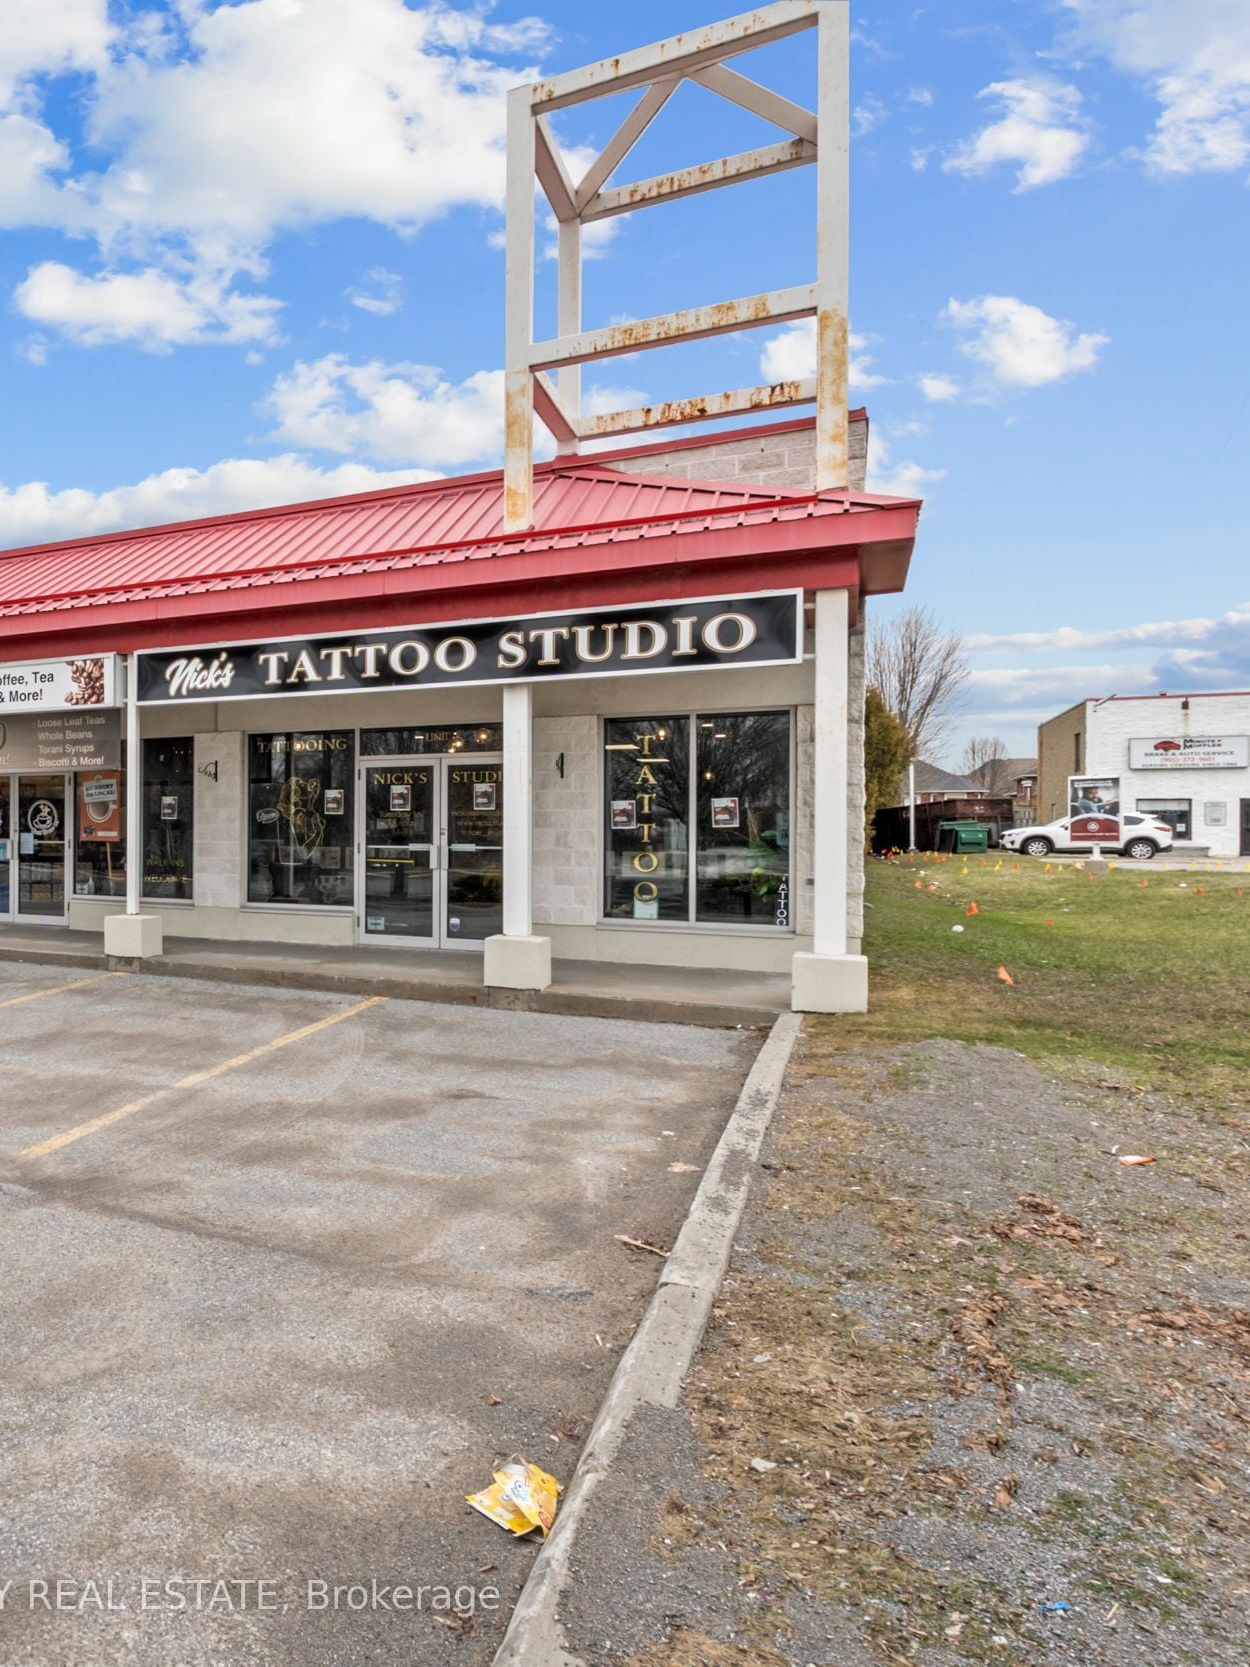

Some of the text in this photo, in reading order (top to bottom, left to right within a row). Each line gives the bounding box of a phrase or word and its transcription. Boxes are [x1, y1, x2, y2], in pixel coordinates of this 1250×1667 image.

[164, 611, 758, 697] Nick's TATTOO STUDIO
[31, 671, 55, 684] Tea
[8, 689, 43, 703] More!
[37, 715, 106, 728] Loose Leaf Teas
[37, 730, 93, 741] Whole Beans
[38, 743, 95, 755] Torani Syrups
[257, 738, 348, 753] TATTOOING
[38, 755, 105, 767] Biscotti & More!
[374, 771, 502, 785] NICK'S STUDI
[632, 734, 659, 903] TATTOO
